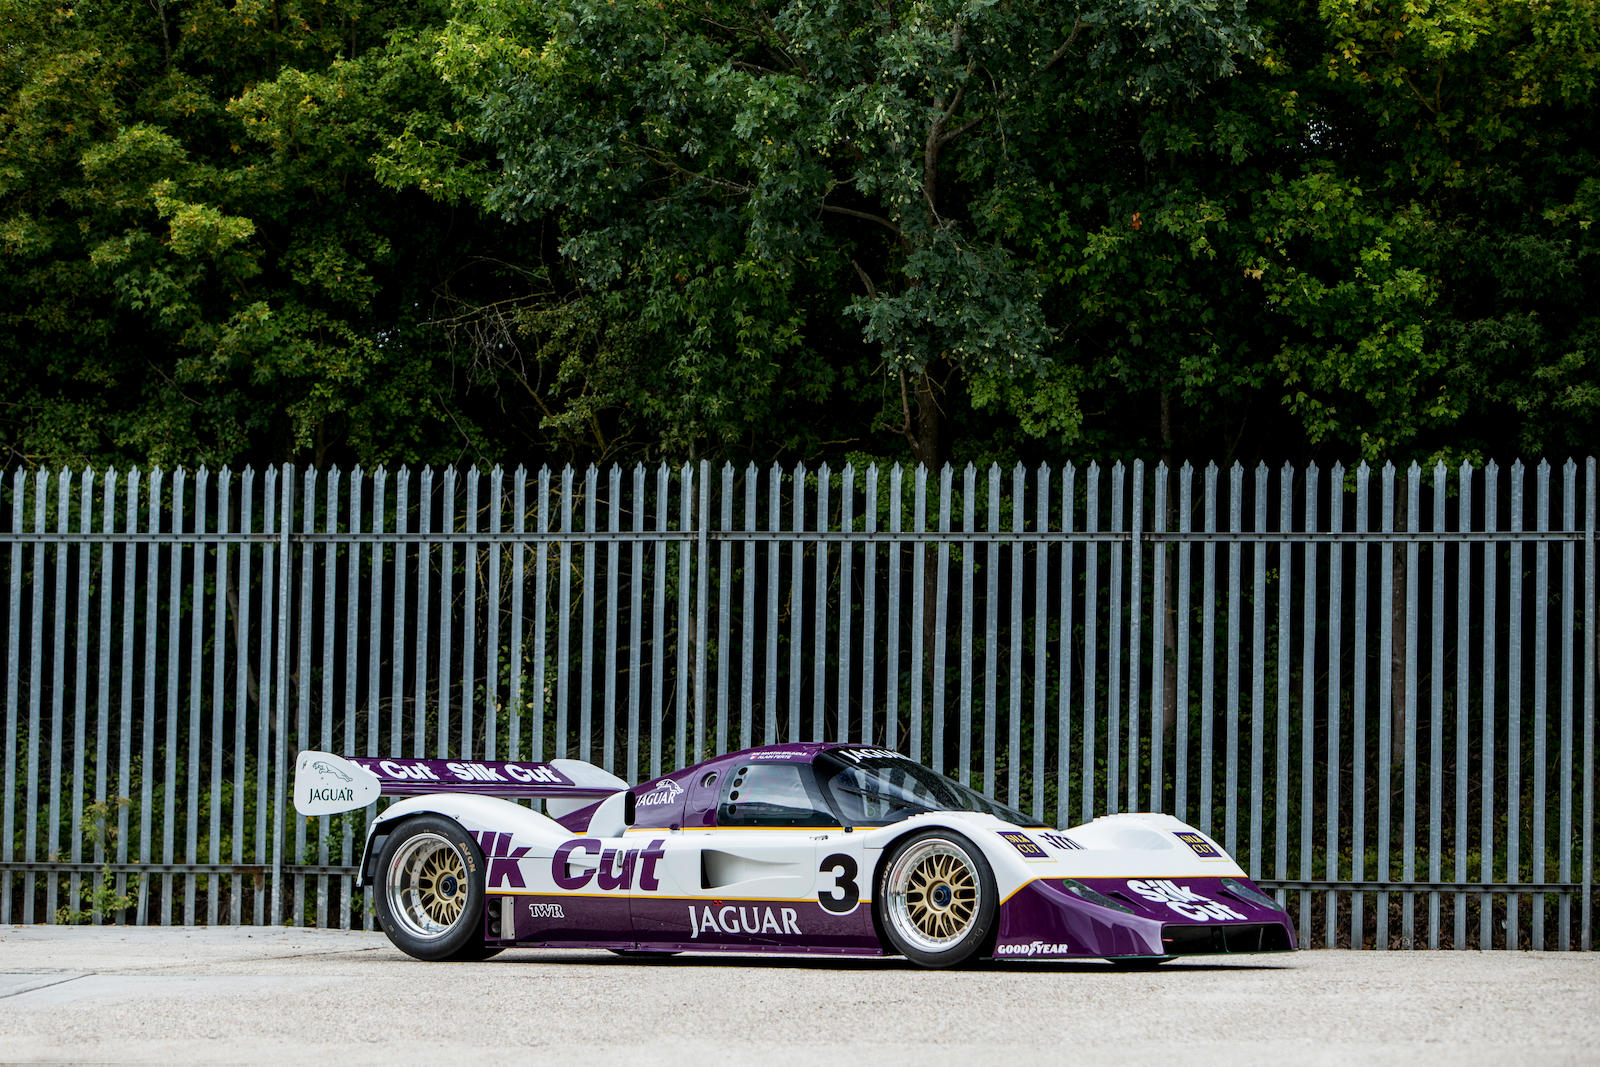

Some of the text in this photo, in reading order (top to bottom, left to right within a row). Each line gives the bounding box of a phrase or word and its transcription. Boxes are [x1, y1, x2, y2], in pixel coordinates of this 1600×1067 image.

[379, 760, 441, 780] Cut
[445, 762, 510, 783] Silk
[504, 763, 562, 783] Cut
[308, 788, 354, 804] JAGUAR
[634, 791, 676, 808] JAGUAR
[1004, 834, 1031, 843] SILK
[1179, 834, 1204, 844] SILK
[458, 841, 476, 873] AVON
[1017, 844, 1041, 854] CUT
[1192, 844, 1215, 854] CUT
[552, 838, 666, 891] Cut
[818, 852, 860, 914] 3
[1126, 879, 1212, 904] Silk
[529, 903, 565, 919] TWR
[1165, 900, 1249, 922] Cut
[688, 905, 803, 939] JAGUAR
[997, 940, 1069, 957] GOODYEAR
